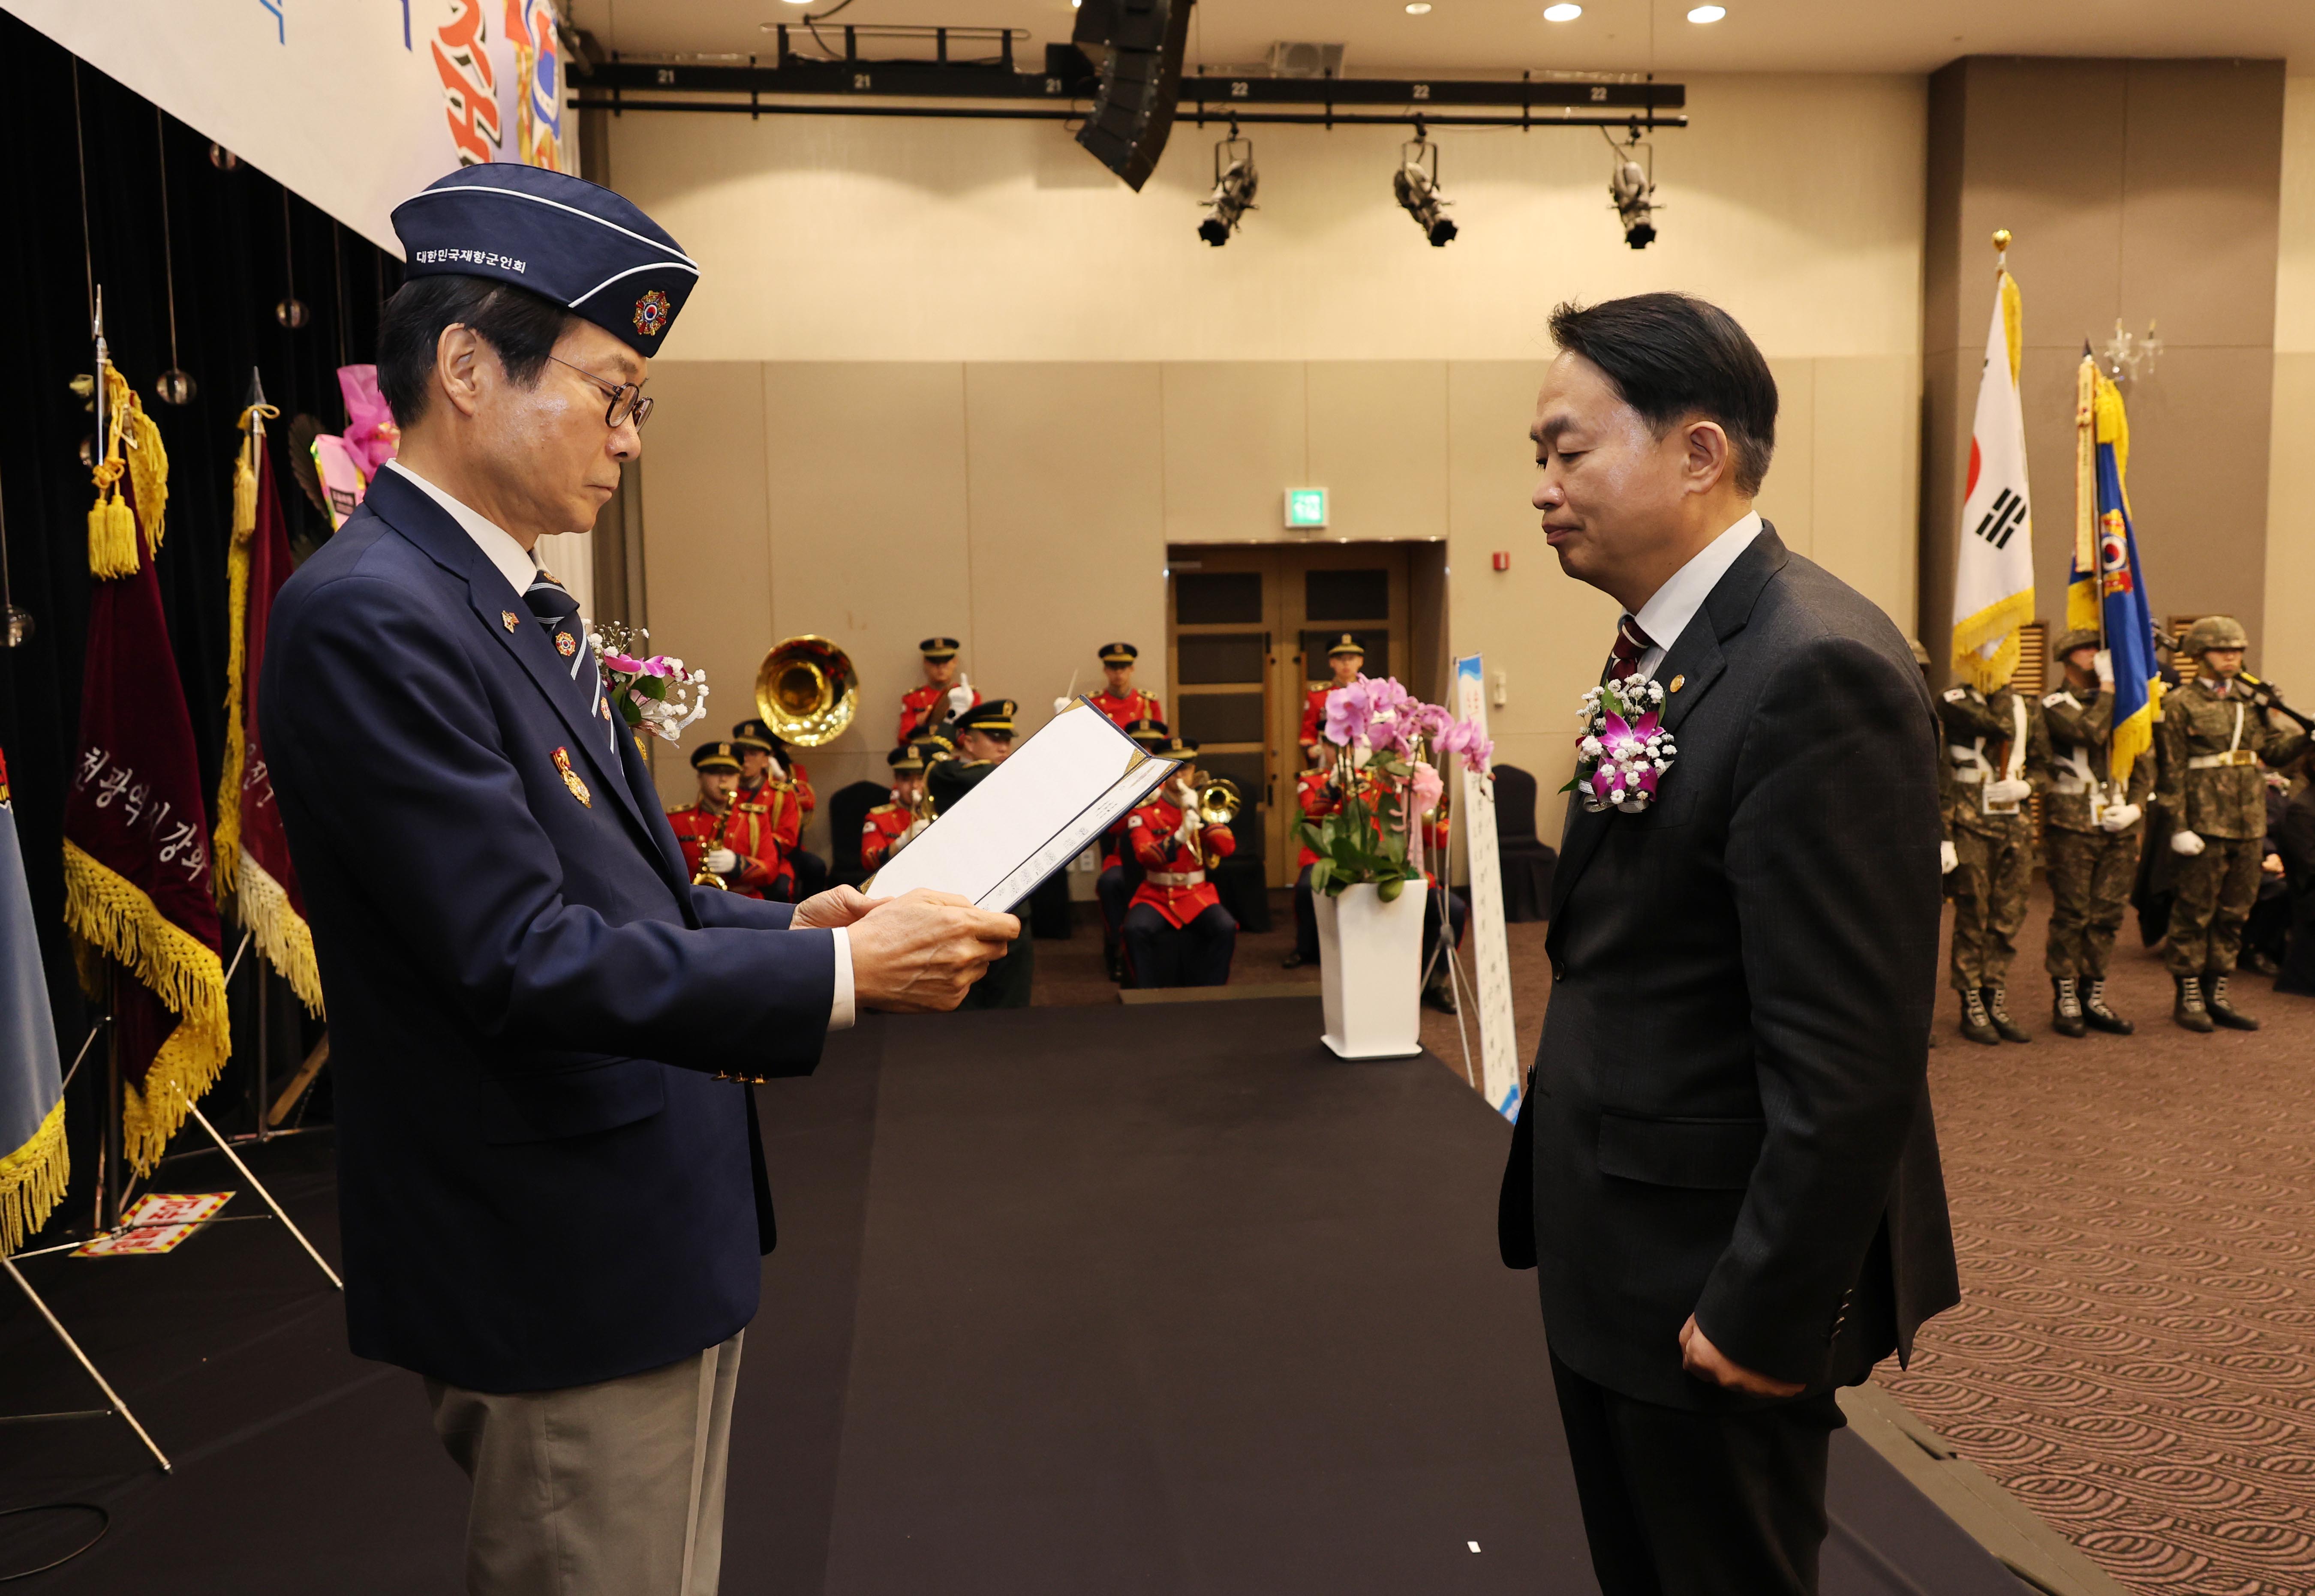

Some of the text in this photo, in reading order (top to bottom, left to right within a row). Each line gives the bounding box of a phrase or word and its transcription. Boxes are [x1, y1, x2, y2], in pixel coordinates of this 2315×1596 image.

[658, 69, 675, 84] 21
[854, 74, 871, 88] 21
[1046, 78, 1062, 93] 21
[1231, 82, 1248, 97] 22
[1413, 84, 1430, 99] 22
[1591, 87, 1608, 101] 22
[416, 248, 526, 274] 대한민국재향군인회
